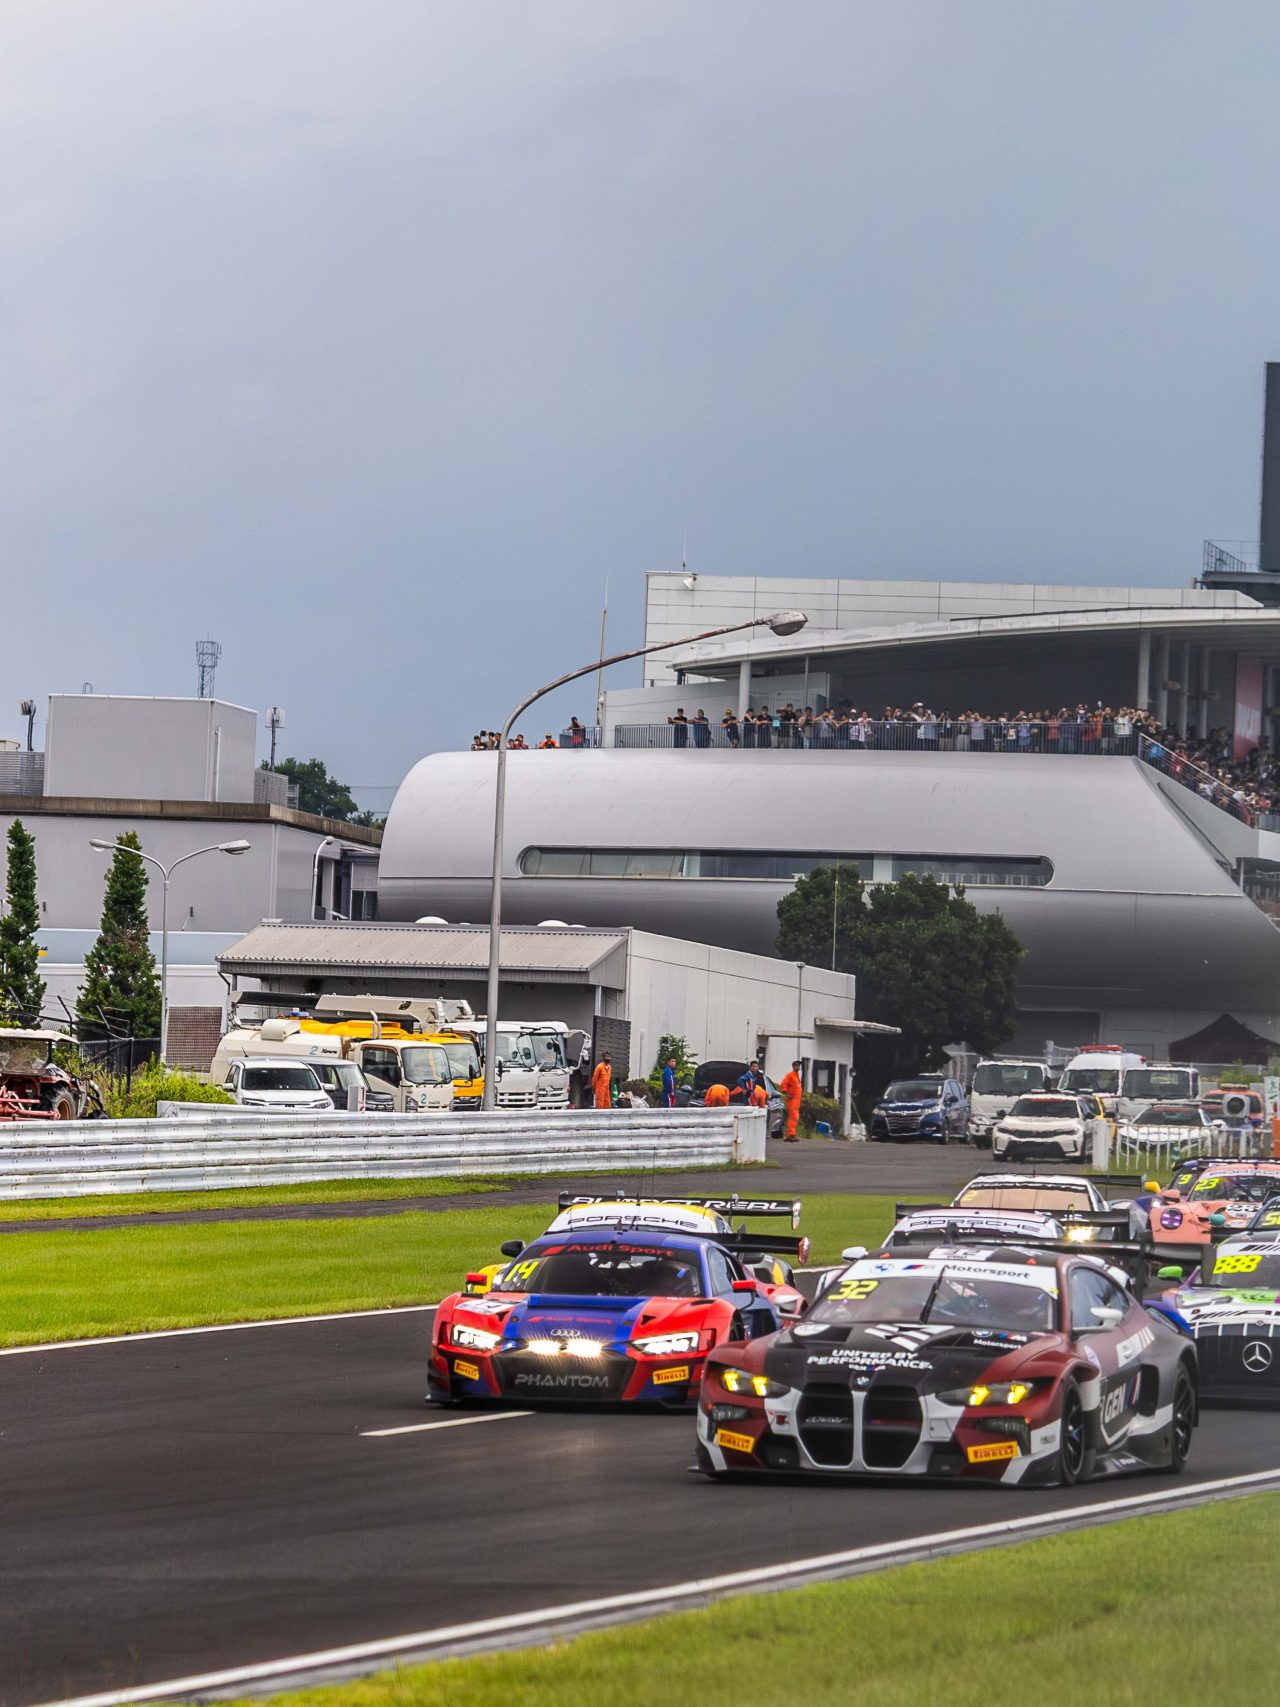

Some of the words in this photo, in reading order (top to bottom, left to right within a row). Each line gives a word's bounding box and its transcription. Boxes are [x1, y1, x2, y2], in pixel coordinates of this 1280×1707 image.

[309, 1045, 319, 1056] 2
[420, 1093, 427, 1104] 2
[1194, 1177, 1220, 1191] 23
[705, 1199, 790, 1211] REAL
[568, 1215, 698, 1229] PORSCHE
[568, 1243, 616, 1253] Audi
[620, 1244, 673, 1257] Sport
[504, 1260, 539, 1282] 14
[944, 1263, 1030, 1279] Motorsport
[1213, 1255, 1262, 1274] 888
[827, 1280, 879, 1300] 32
[832, 1349, 890, 1360] UNITED
[894, 1351, 918, 1360] BY
[515, 1373, 609, 1387] PHANTOM
[655, 1369, 688, 1381] PIRELLI
[973, 1445, 1014, 1459] PIRELLI
